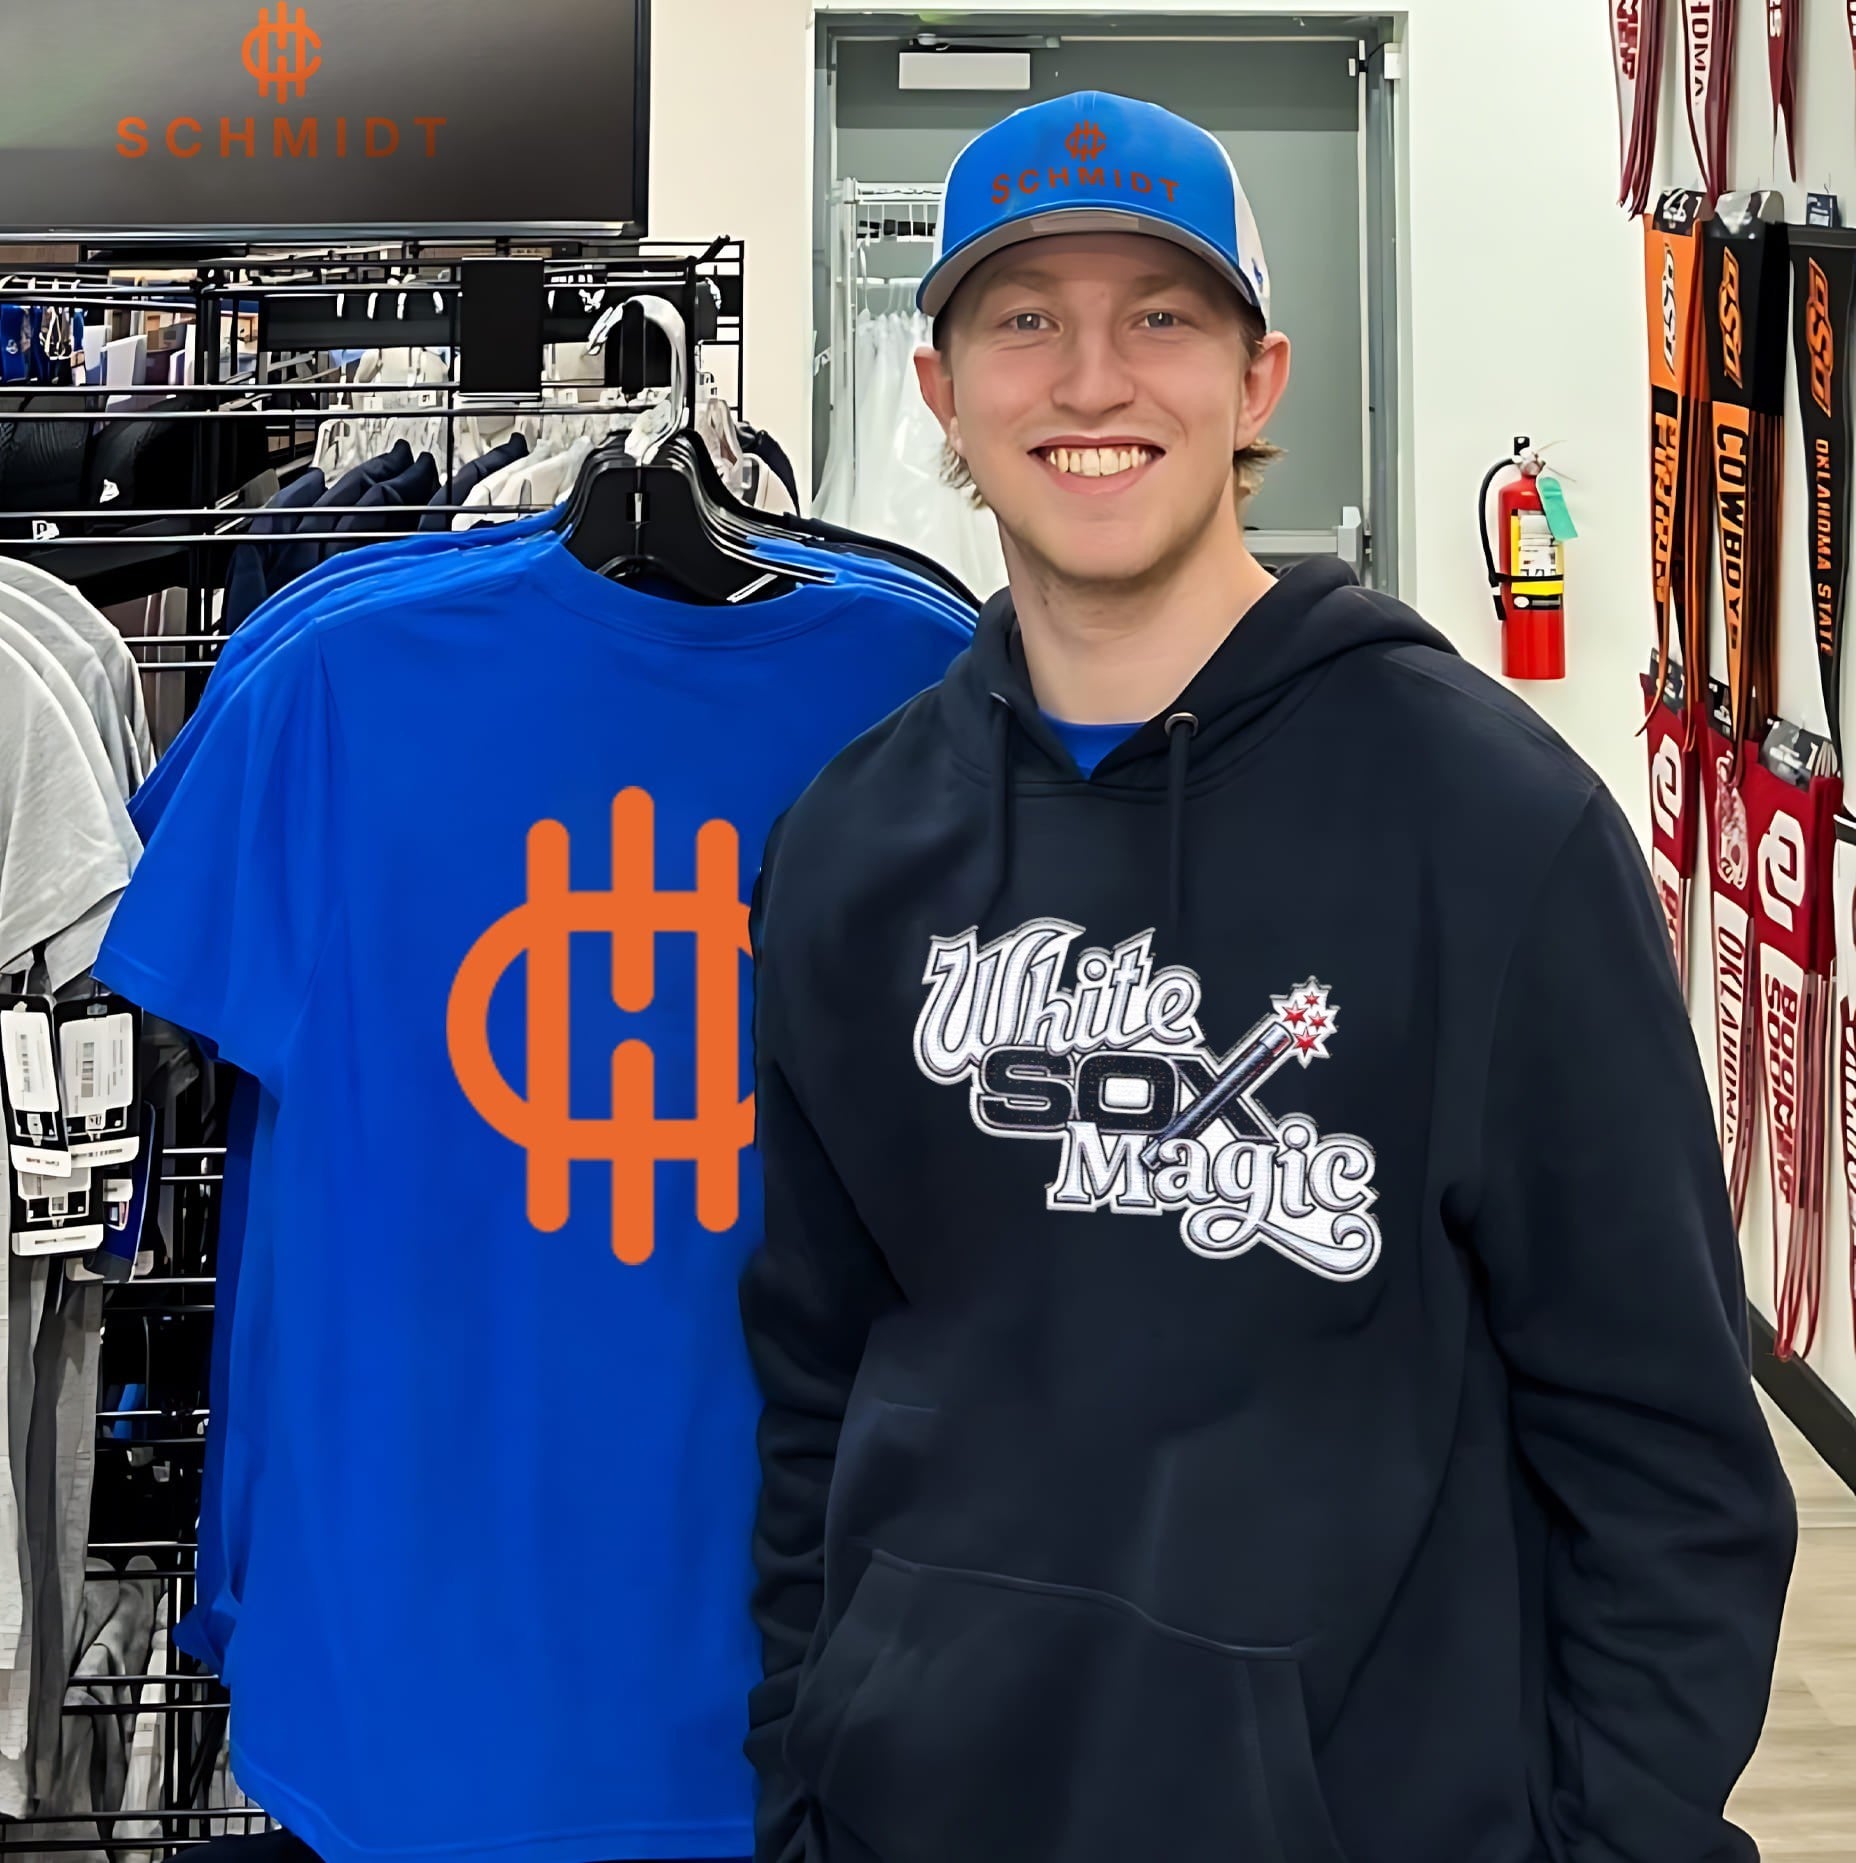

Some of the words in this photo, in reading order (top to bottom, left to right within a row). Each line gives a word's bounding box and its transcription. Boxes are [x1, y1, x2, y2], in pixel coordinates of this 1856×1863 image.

[115, 116, 447, 158] SCHMIDT
[991, 167, 1179, 204] SCHMIDT
[1815, 438, 1831, 570] OKLAHOMA
[914, 919, 1204, 1083] White
[974, 1020, 1294, 1142] SOX
[1048, 1115, 1380, 1281] Magic
